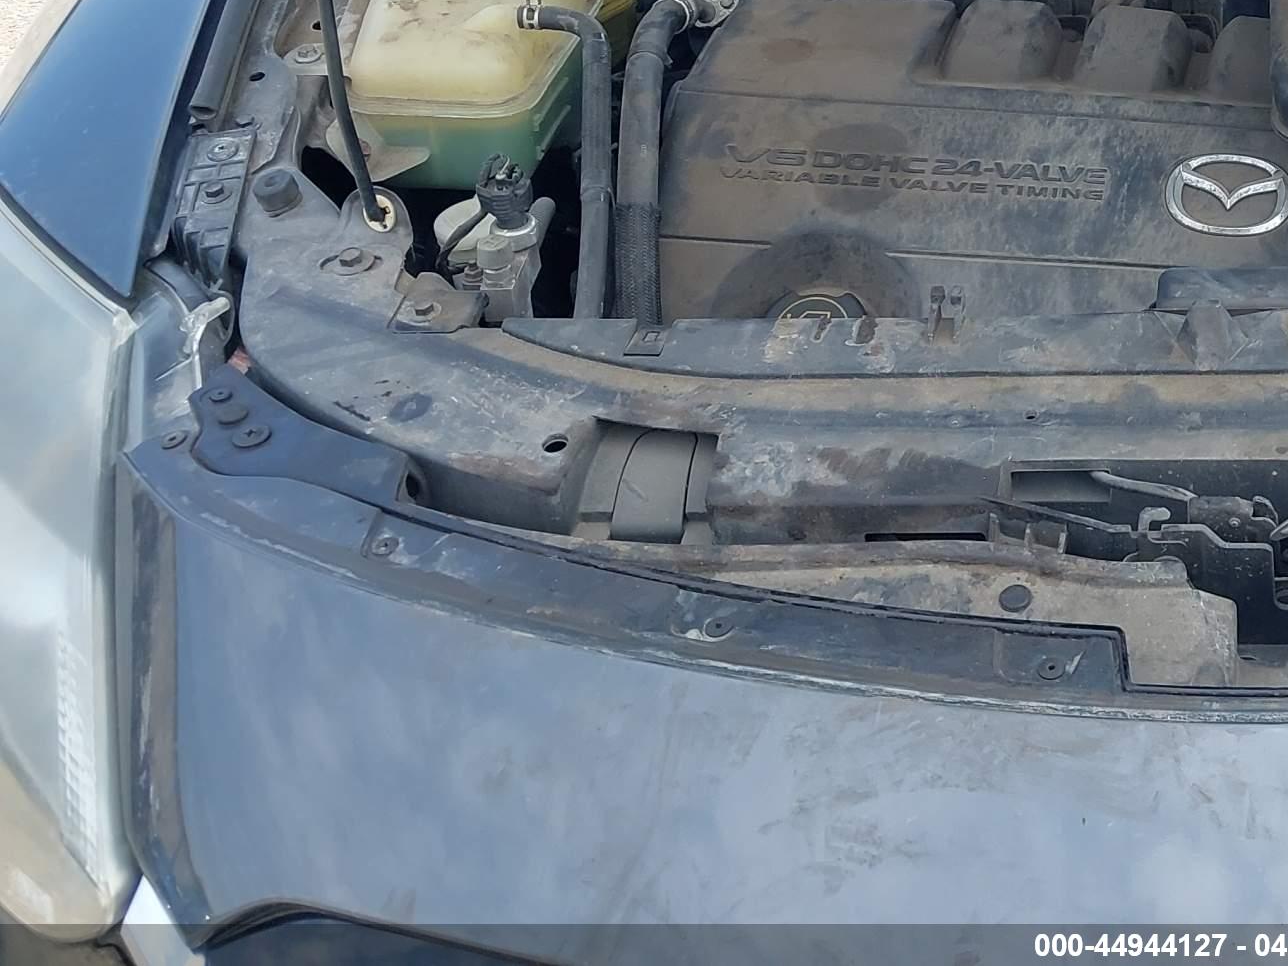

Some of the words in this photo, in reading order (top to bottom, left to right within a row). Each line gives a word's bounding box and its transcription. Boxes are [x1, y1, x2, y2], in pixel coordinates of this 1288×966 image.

[719, 166, 881, 188] VARIABLE
[889, 177, 989, 195] VALVE
[995, 184, 1105, 201] TIMING
[726, 144, 808, 167] V6
[813, 150, 929, 174] DOHC
[931, 158, 1108, 185] 24-VALVE
